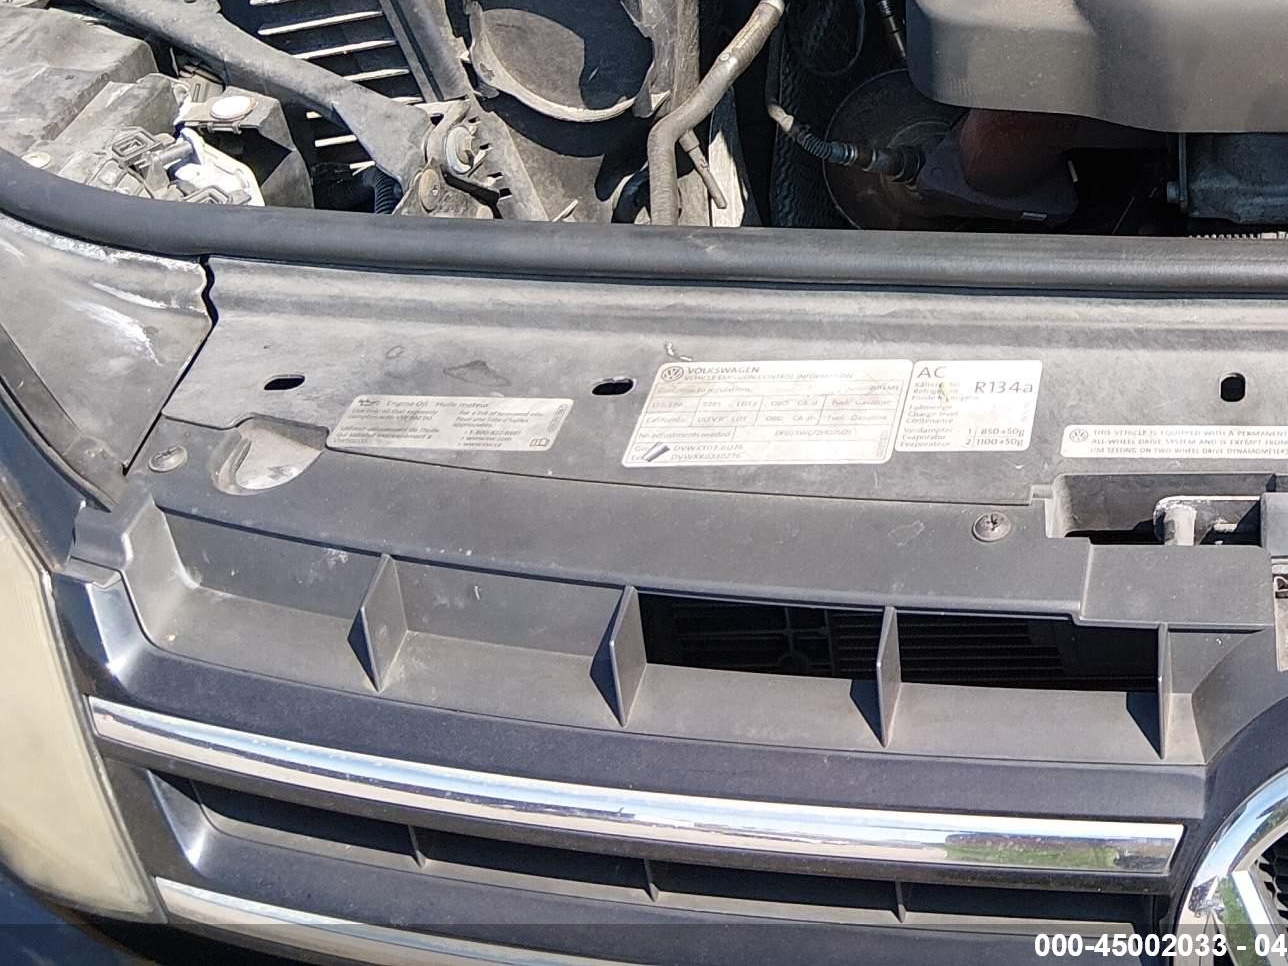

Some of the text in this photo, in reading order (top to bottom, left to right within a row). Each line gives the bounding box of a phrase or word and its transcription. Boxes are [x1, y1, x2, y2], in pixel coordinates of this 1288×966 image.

[687, 366, 760, 374] VOLKSWAGEN
[917, 366, 947, 378] AC
[974, 381, 1033, 394] R134a
